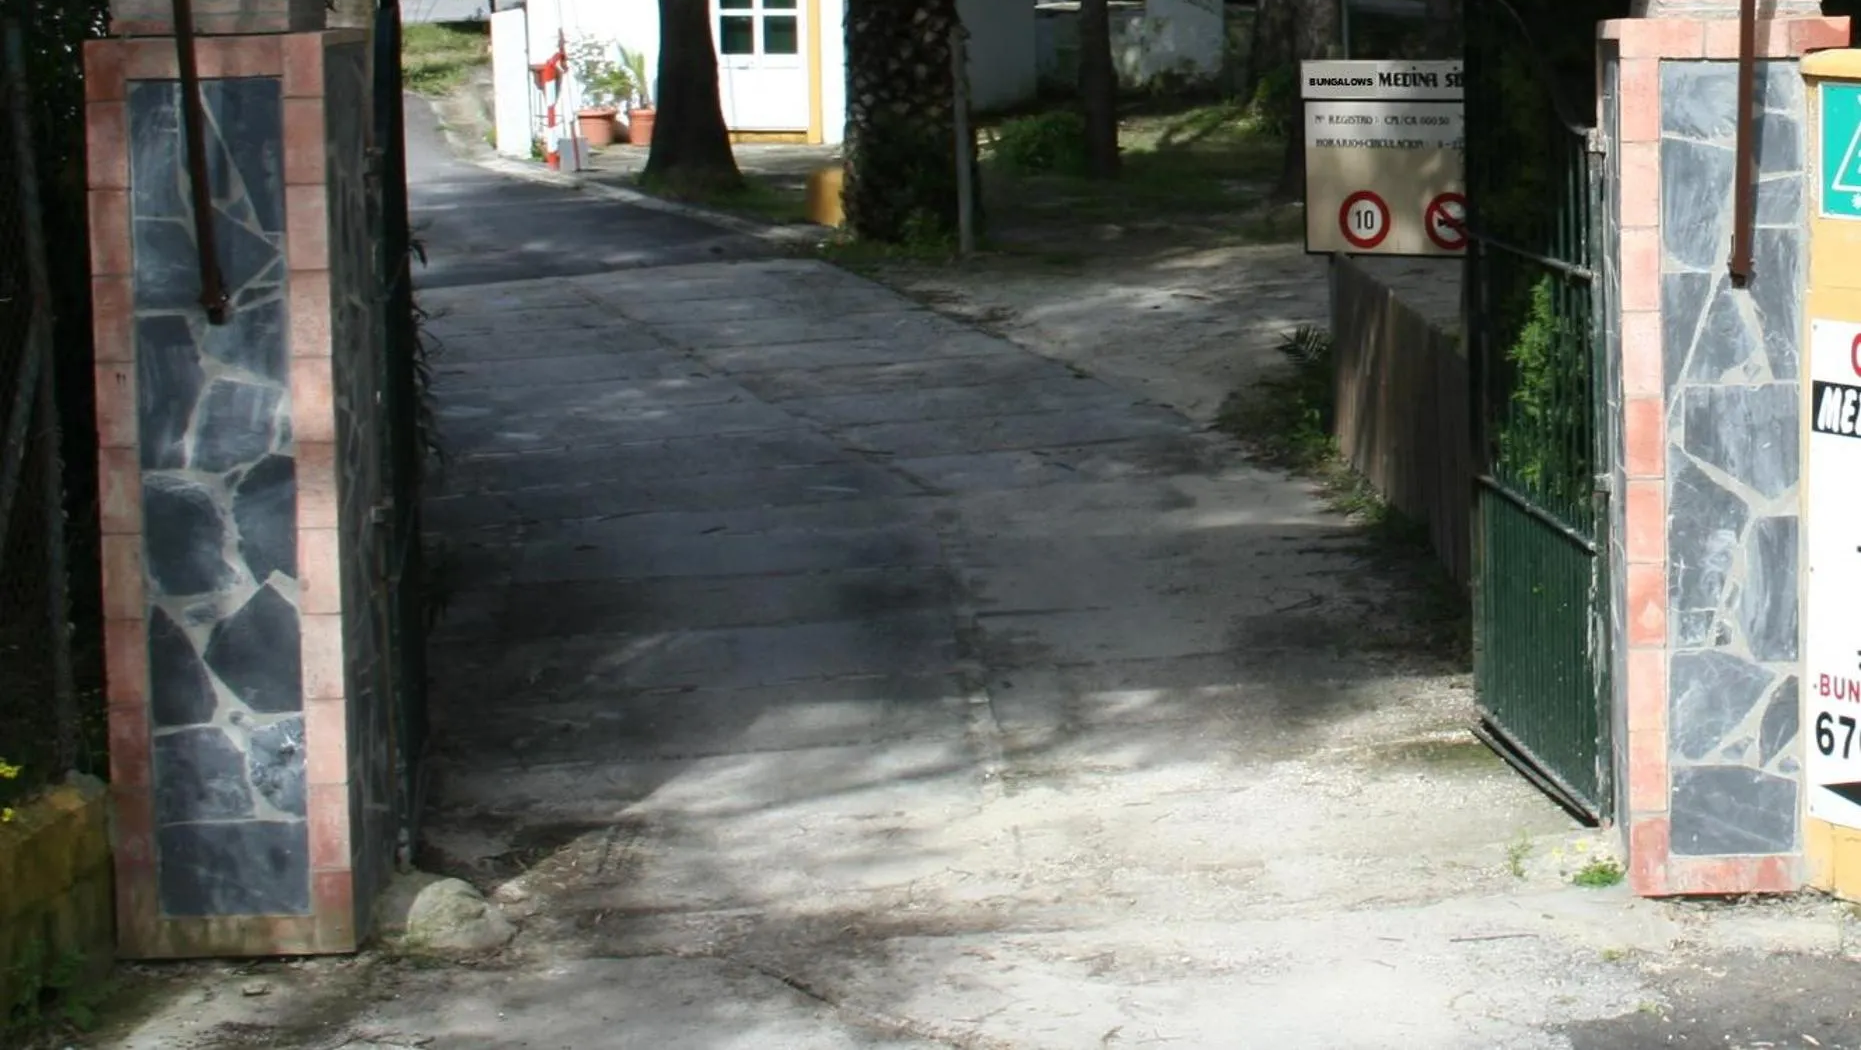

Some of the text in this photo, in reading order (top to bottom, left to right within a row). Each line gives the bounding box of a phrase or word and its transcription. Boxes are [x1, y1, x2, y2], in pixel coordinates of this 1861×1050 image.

[1308, 77, 1374, 87] BUNGALOWS
[1355, 210, 1374, 230] 10
[1819, 673, 1861, 704] BUN
[1815, 710, 1861, 760] 67
